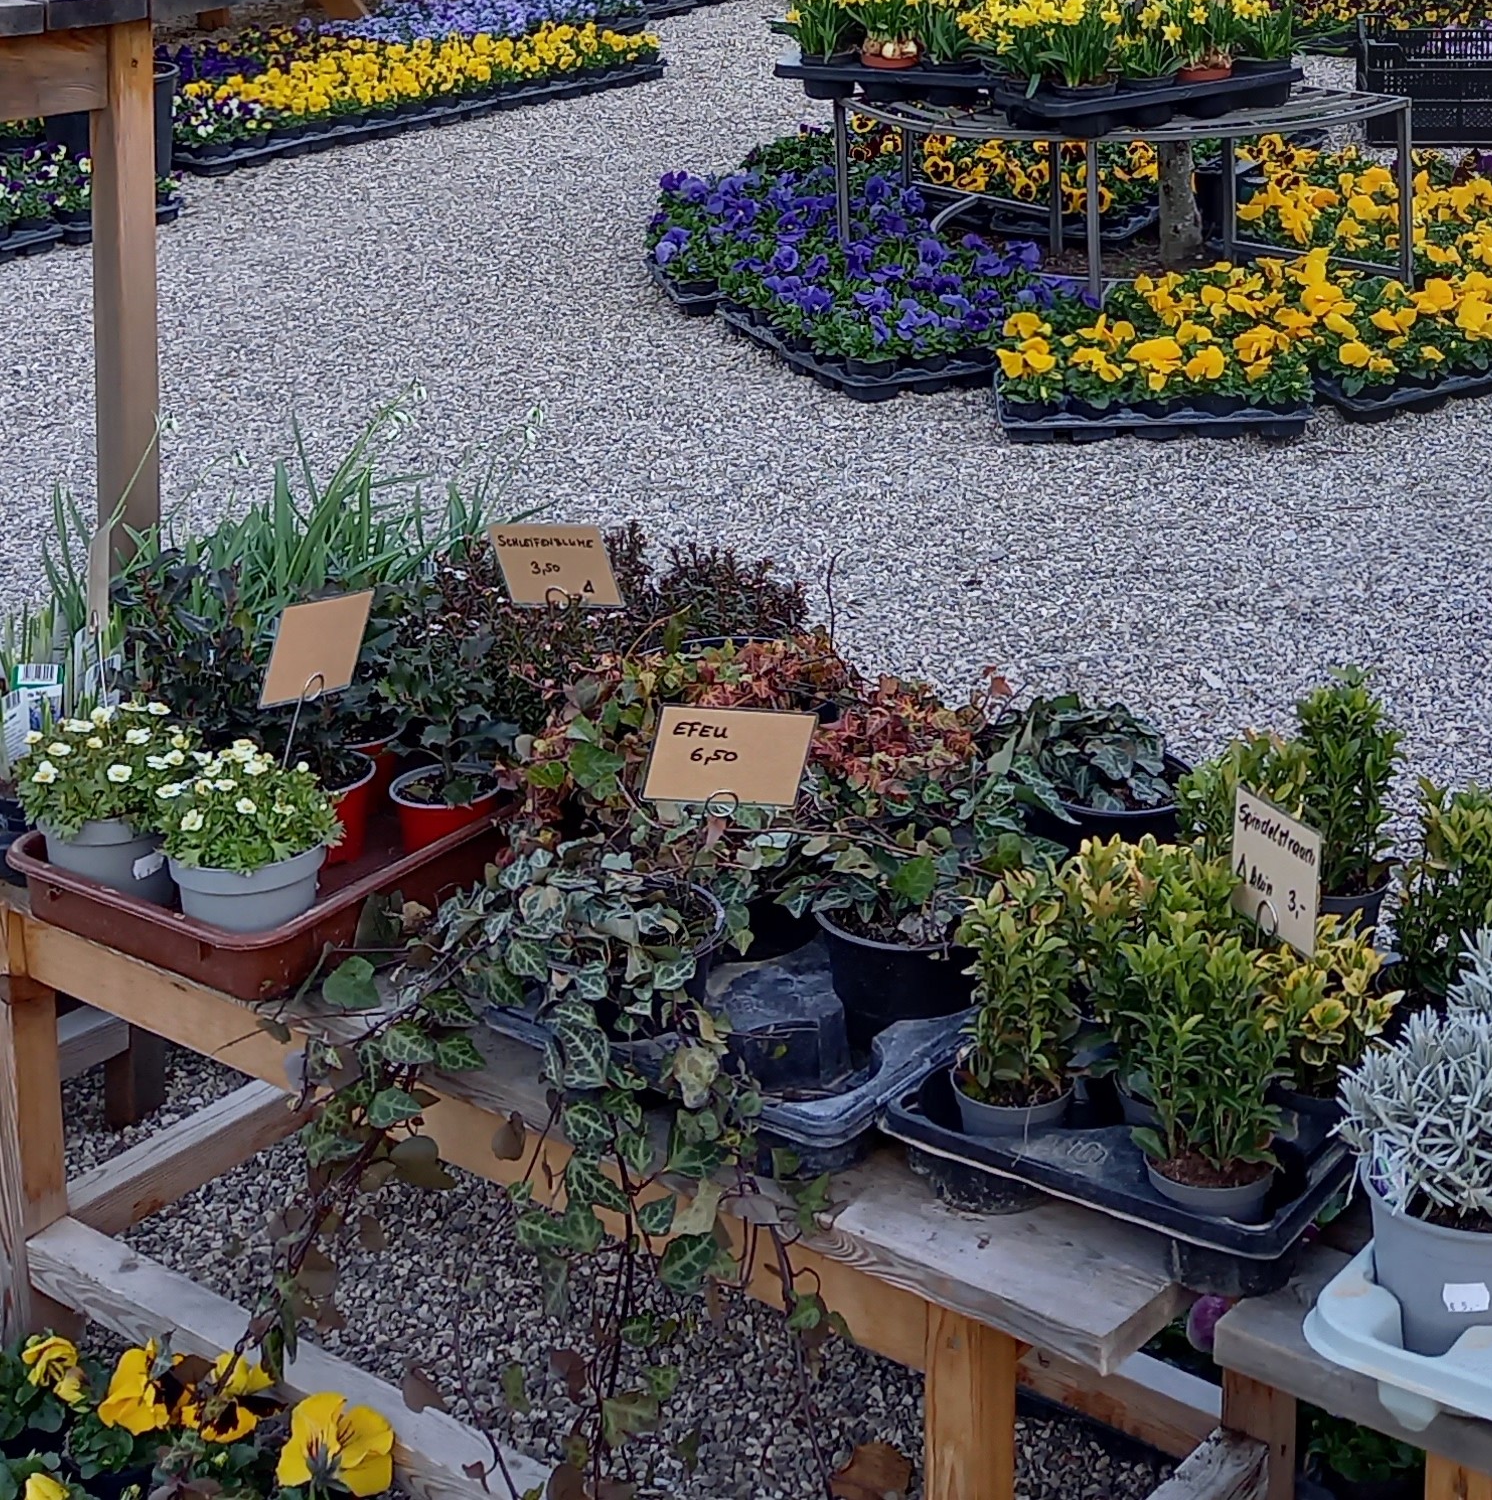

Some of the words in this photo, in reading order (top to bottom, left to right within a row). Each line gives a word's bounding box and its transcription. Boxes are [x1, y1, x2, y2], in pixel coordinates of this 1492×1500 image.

[530, 561, 561, 575] 3,50
[673, 722, 728, 739] EFEU
[690, 748, 738, 765] 6,50
[1288, 890, 1306, 919] 3,-
